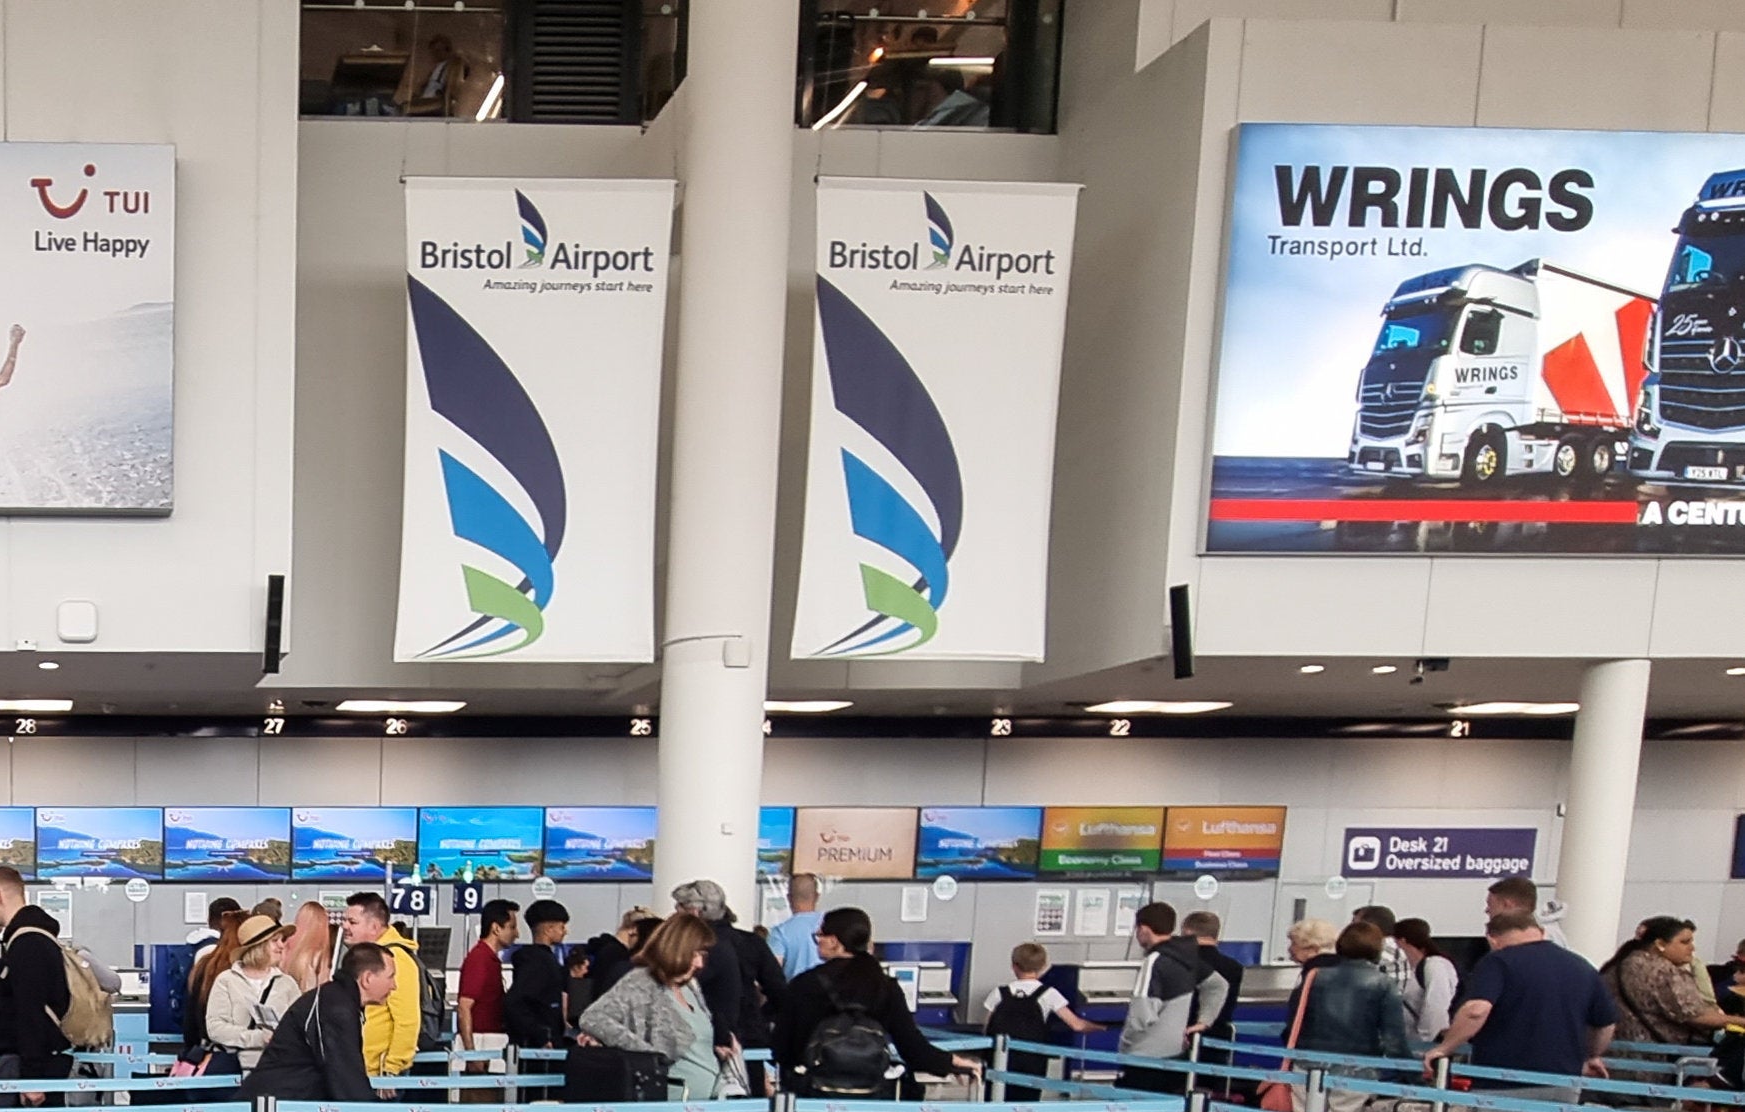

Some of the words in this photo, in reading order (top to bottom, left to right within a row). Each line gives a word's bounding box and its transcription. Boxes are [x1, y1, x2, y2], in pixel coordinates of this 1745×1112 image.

[104, 192, 148, 213] TUI
[1275, 165, 1594, 231] WRINGS
[35, 231, 76, 251] Live
[83, 232, 149, 258] Happy
[1268, 235, 1377, 260] Transport
[1388, 238, 1427, 256] Ltd.
[421, 242, 511, 269] Bristol
[550, 243, 653, 278] Airport
[830, 241, 918, 269] Bristol
[955, 245, 1054, 280] Airport
[483, 279, 537, 293] Amazing
[539, 283, 591, 293] journeys
[595, 282, 623, 291] start
[627, 282, 653, 292] here
[890, 280, 942, 294] Amazing
[943, 284, 994, 295] journeys
[998, 284, 1025, 294] start
[1029, 284, 1053, 295] here
[1455, 366, 1517, 383] WRINGS
[1642, 501, 1663, 525] A
[1668, 499, 1745, 525] CENT
[16, 719, 37, 733] 28
[264, 718, 284, 734] 27
[386, 718, 406, 734] 26
[631, 719, 651, 735] 25
[991, 719, 1011, 735] 23
[1110, 720, 1130, 735] 22
[1451, 721, 1469, 737] 21
[1079, 822, 1156, 839] Lufthansa
[1202, 821, 1280, 837] Lufthansa
[1390, 837, 1427, 852] Desk
[1433, 837, 1448, 852] 21
[818, 847, 892, 862] PREMIUM
[1386, 854, 1461, 870] Oversized
[1466, 855, 1529, 874] baggage
[391, 889, 405, 909] 7
[410, 891, 424, 910] 8
[465, 888, 477, 909] 9
